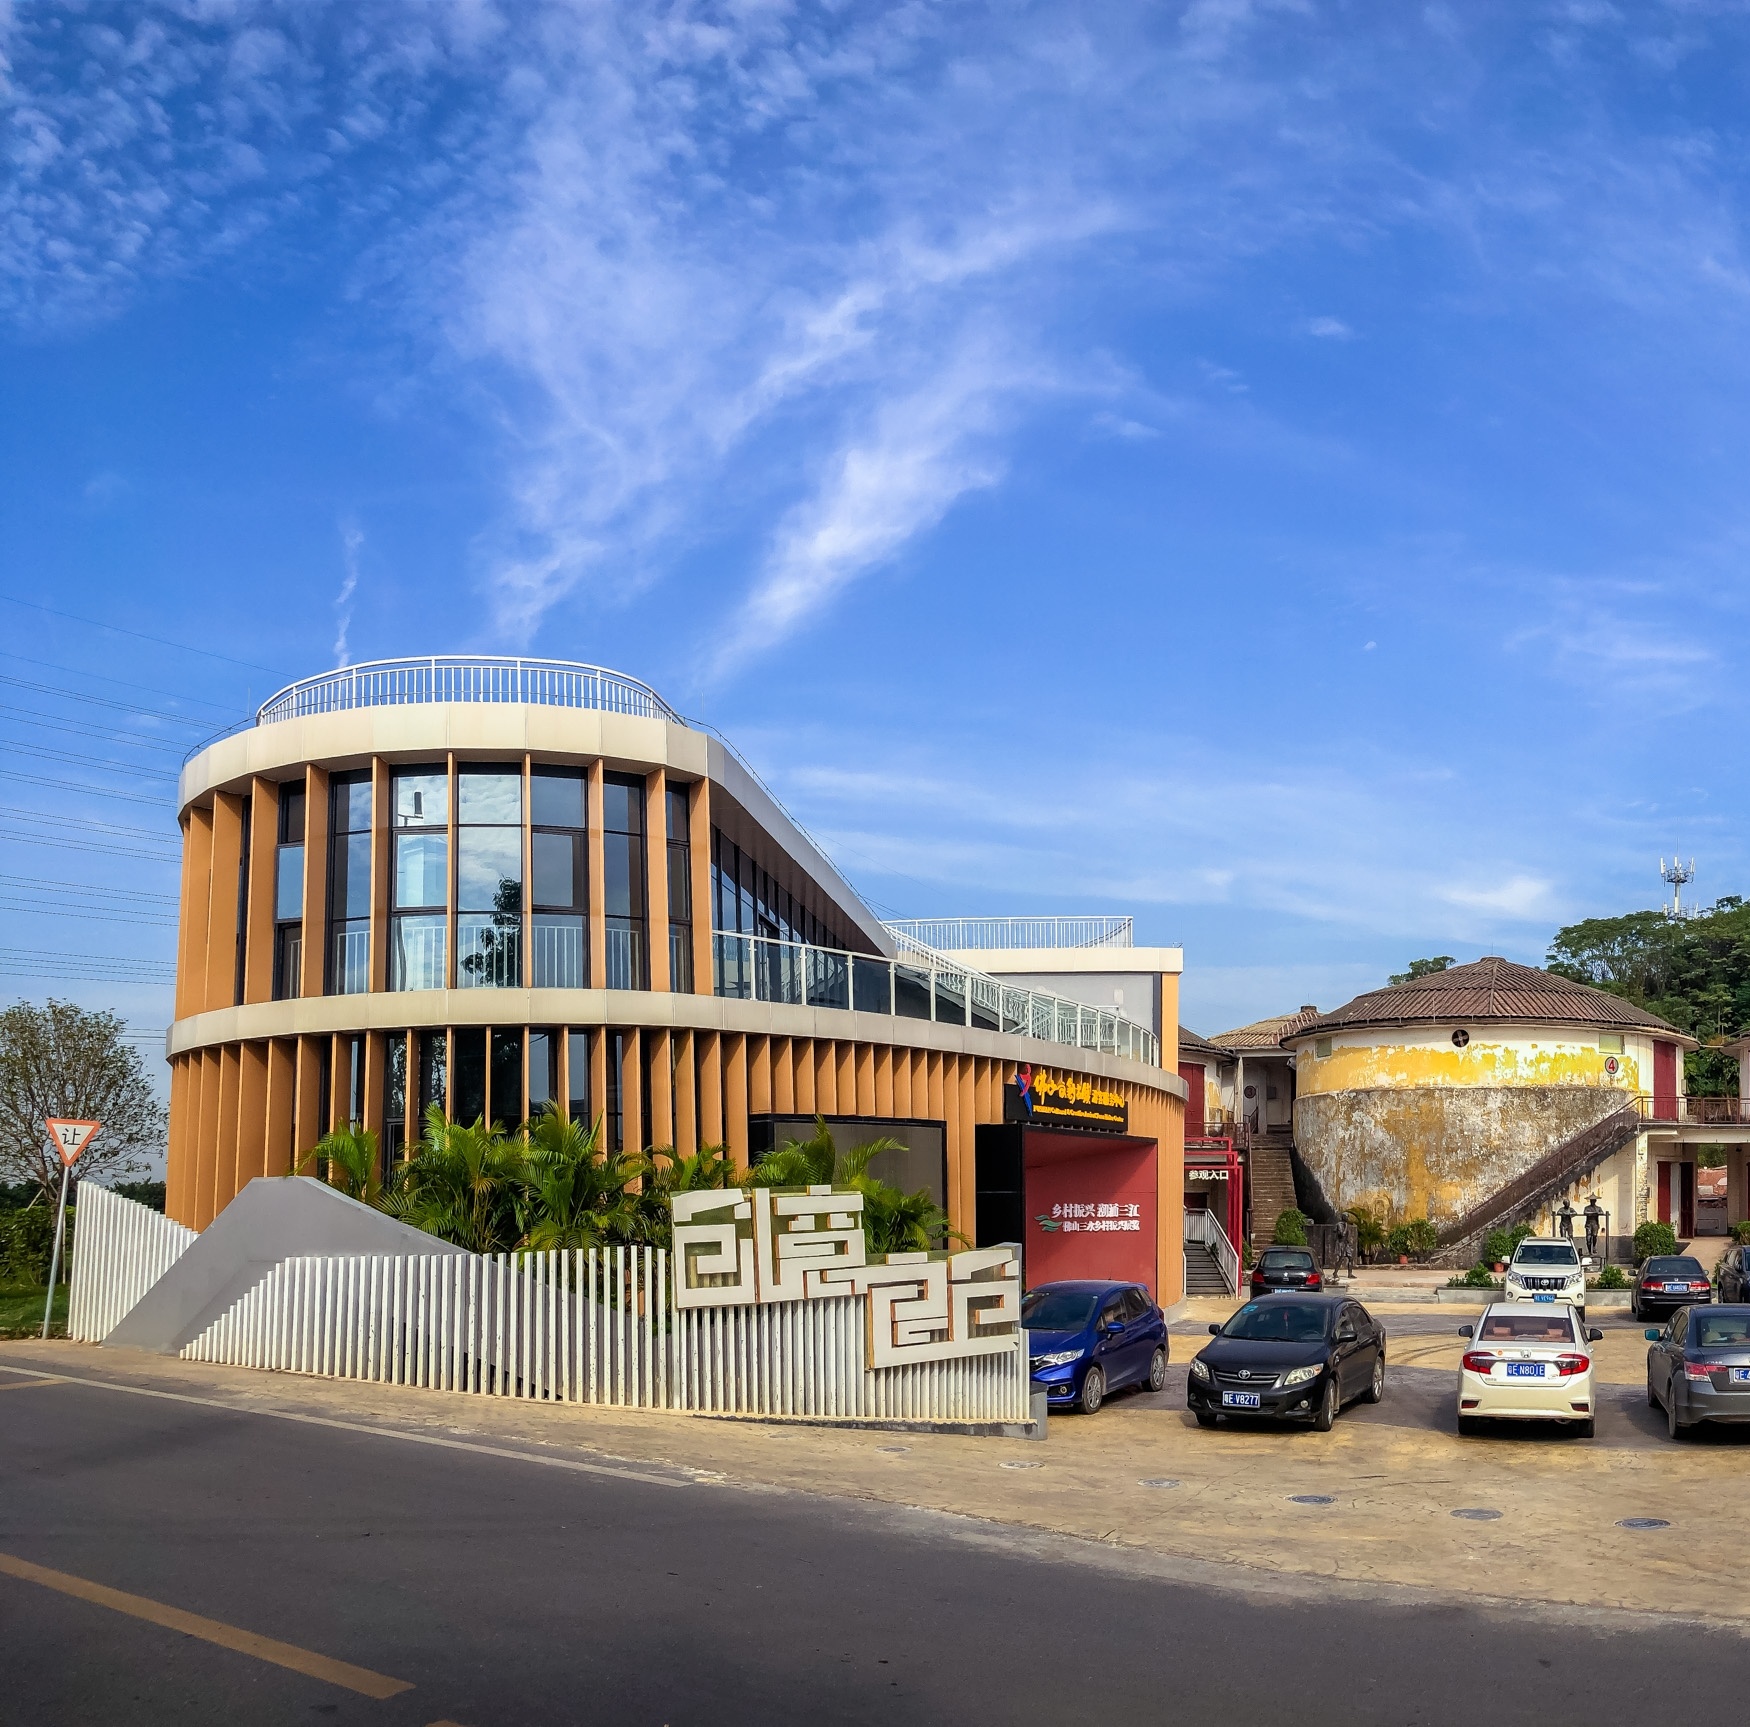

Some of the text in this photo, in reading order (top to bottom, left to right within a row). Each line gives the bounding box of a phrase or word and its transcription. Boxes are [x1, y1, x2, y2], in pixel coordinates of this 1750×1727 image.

[1608, 1059, 1616, 1072] 4
[1246, 1087, 1253, 1097] 3
[62, 1127, 81, 1145] 让
[1188, 1170, 1229, 1180] 参观入口
[1051, 1203, 1096, 1218] 乡村振兴
